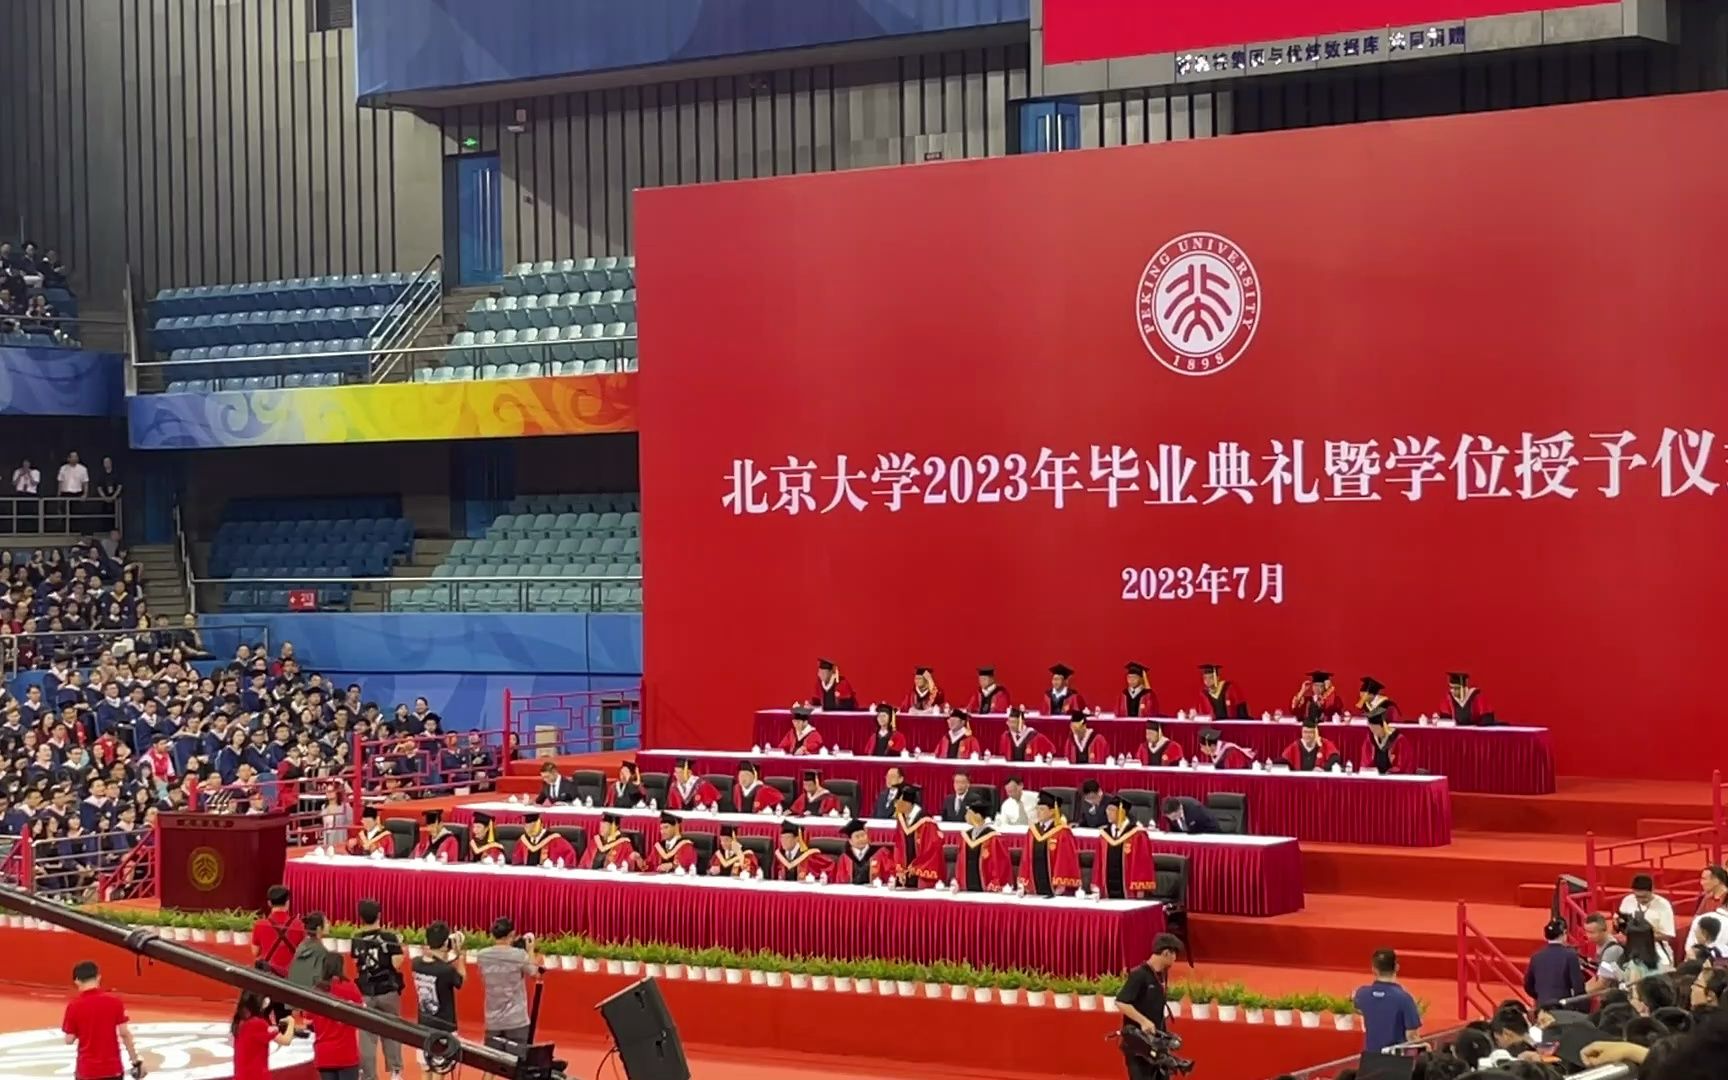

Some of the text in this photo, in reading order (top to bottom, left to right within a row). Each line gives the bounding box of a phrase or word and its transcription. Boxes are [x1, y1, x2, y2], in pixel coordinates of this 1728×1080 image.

[1141, 237, 1256, 334] PEKING UNIVERSITY
[1173, 352, 1224, 370] 1898
[722, 427, 1728, 515] 北京大学2023年毕业典礼暨学位授予仪
[1121, 563, 1283, 605] 2023年7月
